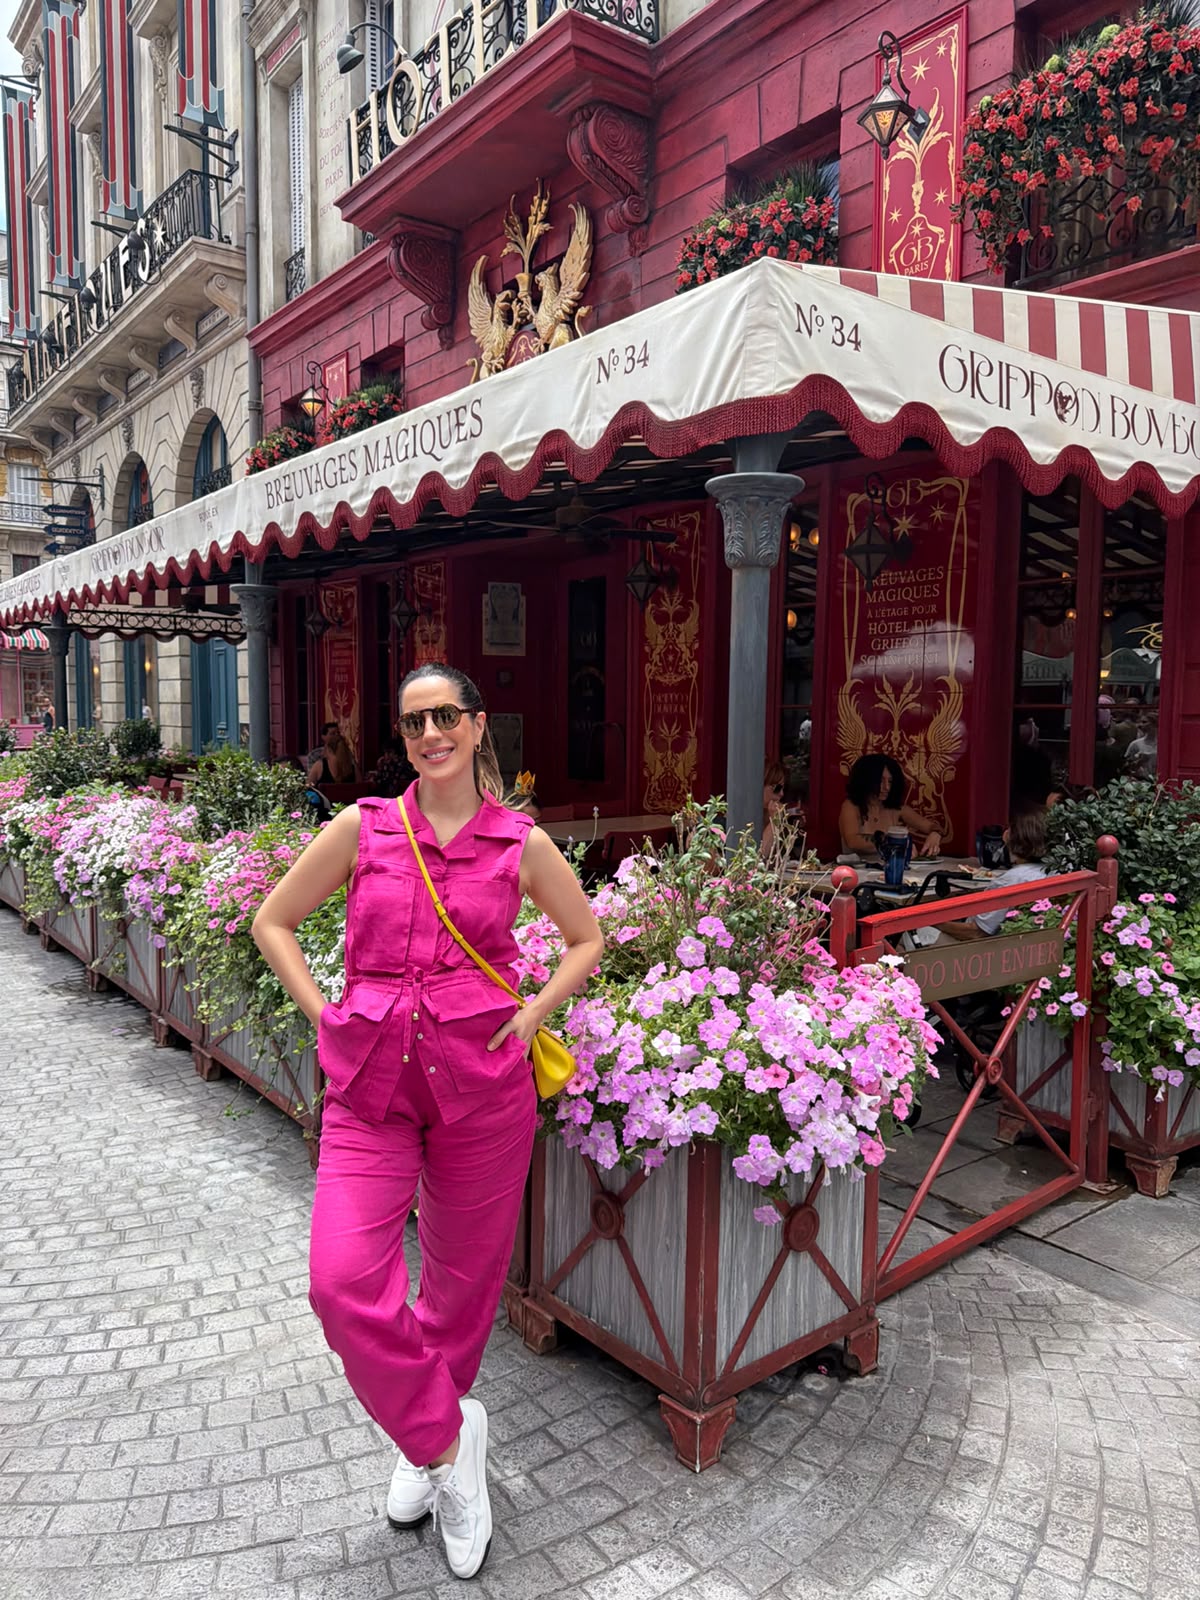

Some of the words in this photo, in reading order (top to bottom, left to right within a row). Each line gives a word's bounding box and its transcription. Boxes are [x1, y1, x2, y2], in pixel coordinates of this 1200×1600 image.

[325, 166, 344, 191] PARIS
[900, 236, 933, 266] GB
[904, 261, 929, 276] PARIS
[831, 314, 862, 352] 34
[624, 339, 649, 375] 34
[265, 449, 358, 510] BREUVAGES
[363, 397, 484, 476] MAGIQUES
[864, 565, 944, 589] REUVAGES
[865, 583, 940, 604] MAGIQUES
[911, 604, 938, 615] POUR
[868, 620, 910, 636] HÔTEL
[914, 619, 935, 633] DU
[913, 960, 946, 989] DO
[952, 951, 995, 984] NOT
[1001, 940, 1058, 975] ENTER
